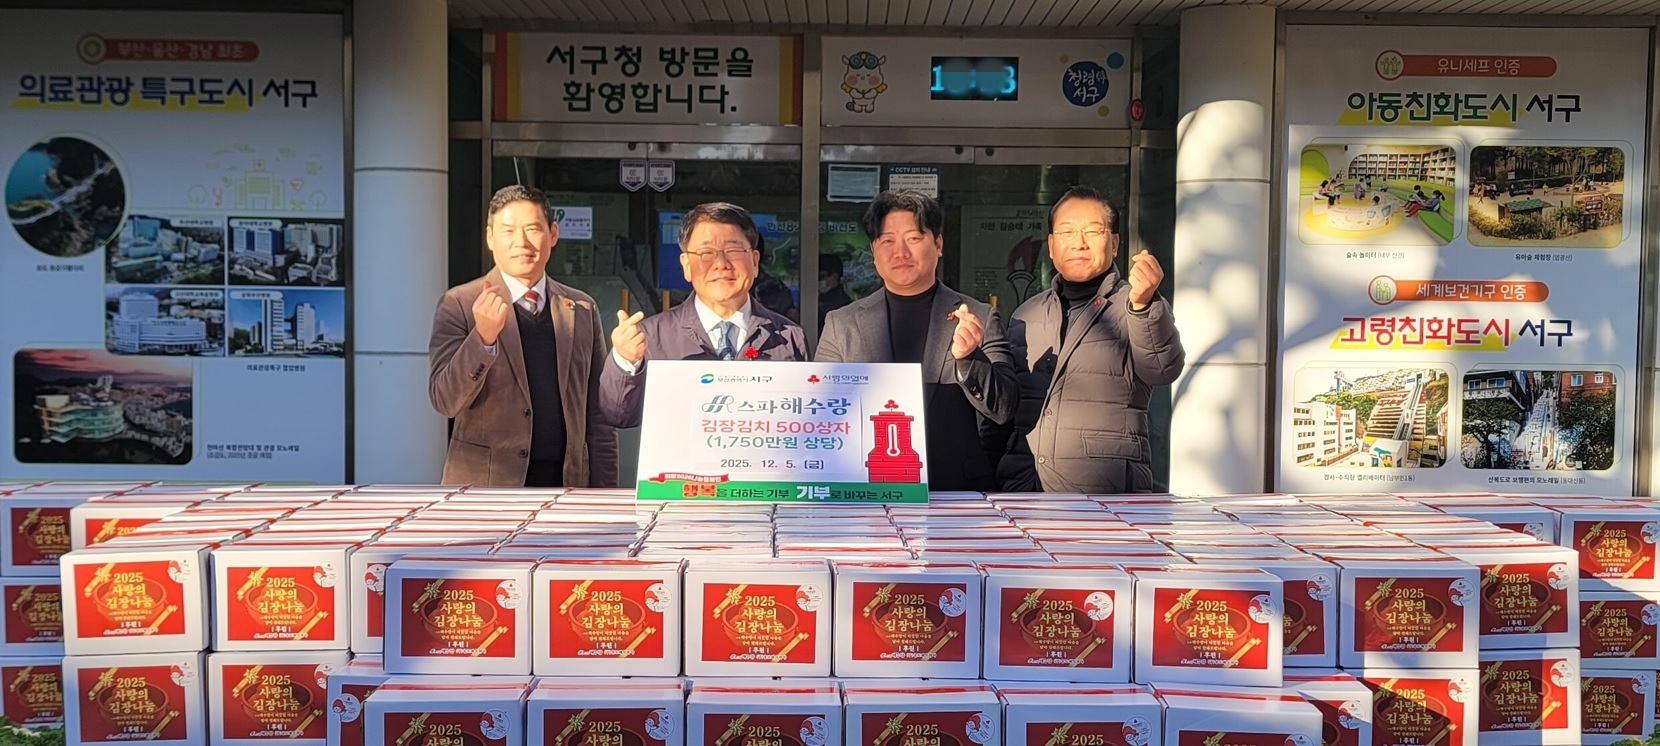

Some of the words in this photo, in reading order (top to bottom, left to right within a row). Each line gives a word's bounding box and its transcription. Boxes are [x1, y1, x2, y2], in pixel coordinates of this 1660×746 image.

[546, 44, 642, 78] 서구청
[658, 46, 754, 78] 방문을
[1437, 59, 1490, 74] 유니세프
[1494, 59, 1520, 76] 인증
[18, 74, 134, 107] 의료관광
[140, 76, 254, 107] 특구도시
[262, 79, 318, 108] 서구
[562, 80, 738, 114] 환영합니다.
[1073, 86, 1100, 102] 서구
[1347, 92, 1518, 122] 아동친화도시
[1526, 94, 1582, 123] 서구
[1416, 282, 1496, 298] 세계보건기구
[1500, 284, 1527, 300] 인증
[1340, 316, 1510, 346] 고령친화도시
[1518, 319, 1574, 348] 서구
[701, 418, 770, 434] 김장김치
[776, 420, 851, 435] 500상자
[706, 435, 798, 450] (1,750만원
[803, 436, 844, 450] 상당)
[720, 459, 752, 468] 2025.
[761, 459, 778, 468] 12.
[786, 460, 796, 468] 5.
[730, 488, 764, 498] 더하는
[767, 489, 789, 498] 기부
[796, 486, 842, 500] 기부로
[844, 491, 878, 500] 바꾸는
[881, 491, 903, 500] 서구
[117, 526, 137, 536] 202
[1601, 538, 1628, 548] 사랑의
[1596, 548, 1632, 558] 김장나눔
[113, 572, 144, 584] 2025
[266, 577, 295, 588] 2025
[1502, 574, 1529, 584] 2025
[112, 584, 146, 597] 사랑의
[263, 589, 298, 601] 사랑의
[444, 590, 474, 600] 2025
[1395, 588, 1424, 598] 2025
[1499, 584, 1532, 596] 사랑의
[591, 591, 622, 602] 2025
[744, 595, 775, 606] 2025
[894, 594, 925, 605] 2025
[1494, 596, 1539, 608] 김장나눔
[106, 597, 154, 610] 김장나눔
[257, 601, 305, 613] 김장나눔
[440, 601, 476, 614] 사랑의
[1042, 600, 1073, 611] 2025
[1196, 600, 1227, 611] 2025
[1392, 599, 1426, 612] 사랑의
[587, 603, 624, 617] 사랑의
[741, 607, 777, 621] 사랑의
[891, 605, 927, 619] 사랑의
[434, 614, 484, 628] 김장나눔
[581, 616, 631, 629] 김장나눔
[1039, 612, 1075, 626] 사랑의
[1192, 612, 1229, 626] 사랑의
[1385, 612, 1433, 624] 김장나눔
[1602, 617, 1628, 627] 사랑의
[735, 620, 784, 634] 김장나눔
[884, 619, 934, 633] 김장나눔
[1032, 625, 1082, 639] 김장나눔
[1186, 625, 1236, 639] 김장나눔
[1597, 627, 1633, 637] 김장나눔
[261, 675, 291, 686] 2025
[1502, 670, 1529, 680] 2025
[116, 677, 146, 688] 2025
[1499, 681, 1532, 693] 사랑의
[115, 688, 148, 701] 사랑의
[259, 686, 293, 698] 사랑의
[1396, 689, 1425, 699] 2025
[1593, 685, 1615, 693] 2025
[1494, 693, 1539, 704] 김장나눔
[1590, 694, 1616, 704] 사랑의
[109, 701, 156, 714] 김장나눔
[253, 699, 300, 711] 김장나눔
[1393, 700, 1427, 712] 사랑의
[1585, 704, 1621, 713] 김장나눔
[1386, 713, 1433, 725] 김장나눔
[429, 724, 462, 736] 2025
[588, 721, 621, 733] 2025
[748, 726, 780, 738] 2025
[906, 724, 938, 736] 2025
[426, 736, 464, 746] 사랑의
[586, 733, 624, 746] 사랑의
[904, 737, 941, 746] 사랑의
[1072, 734, 1104, 746] 2025
